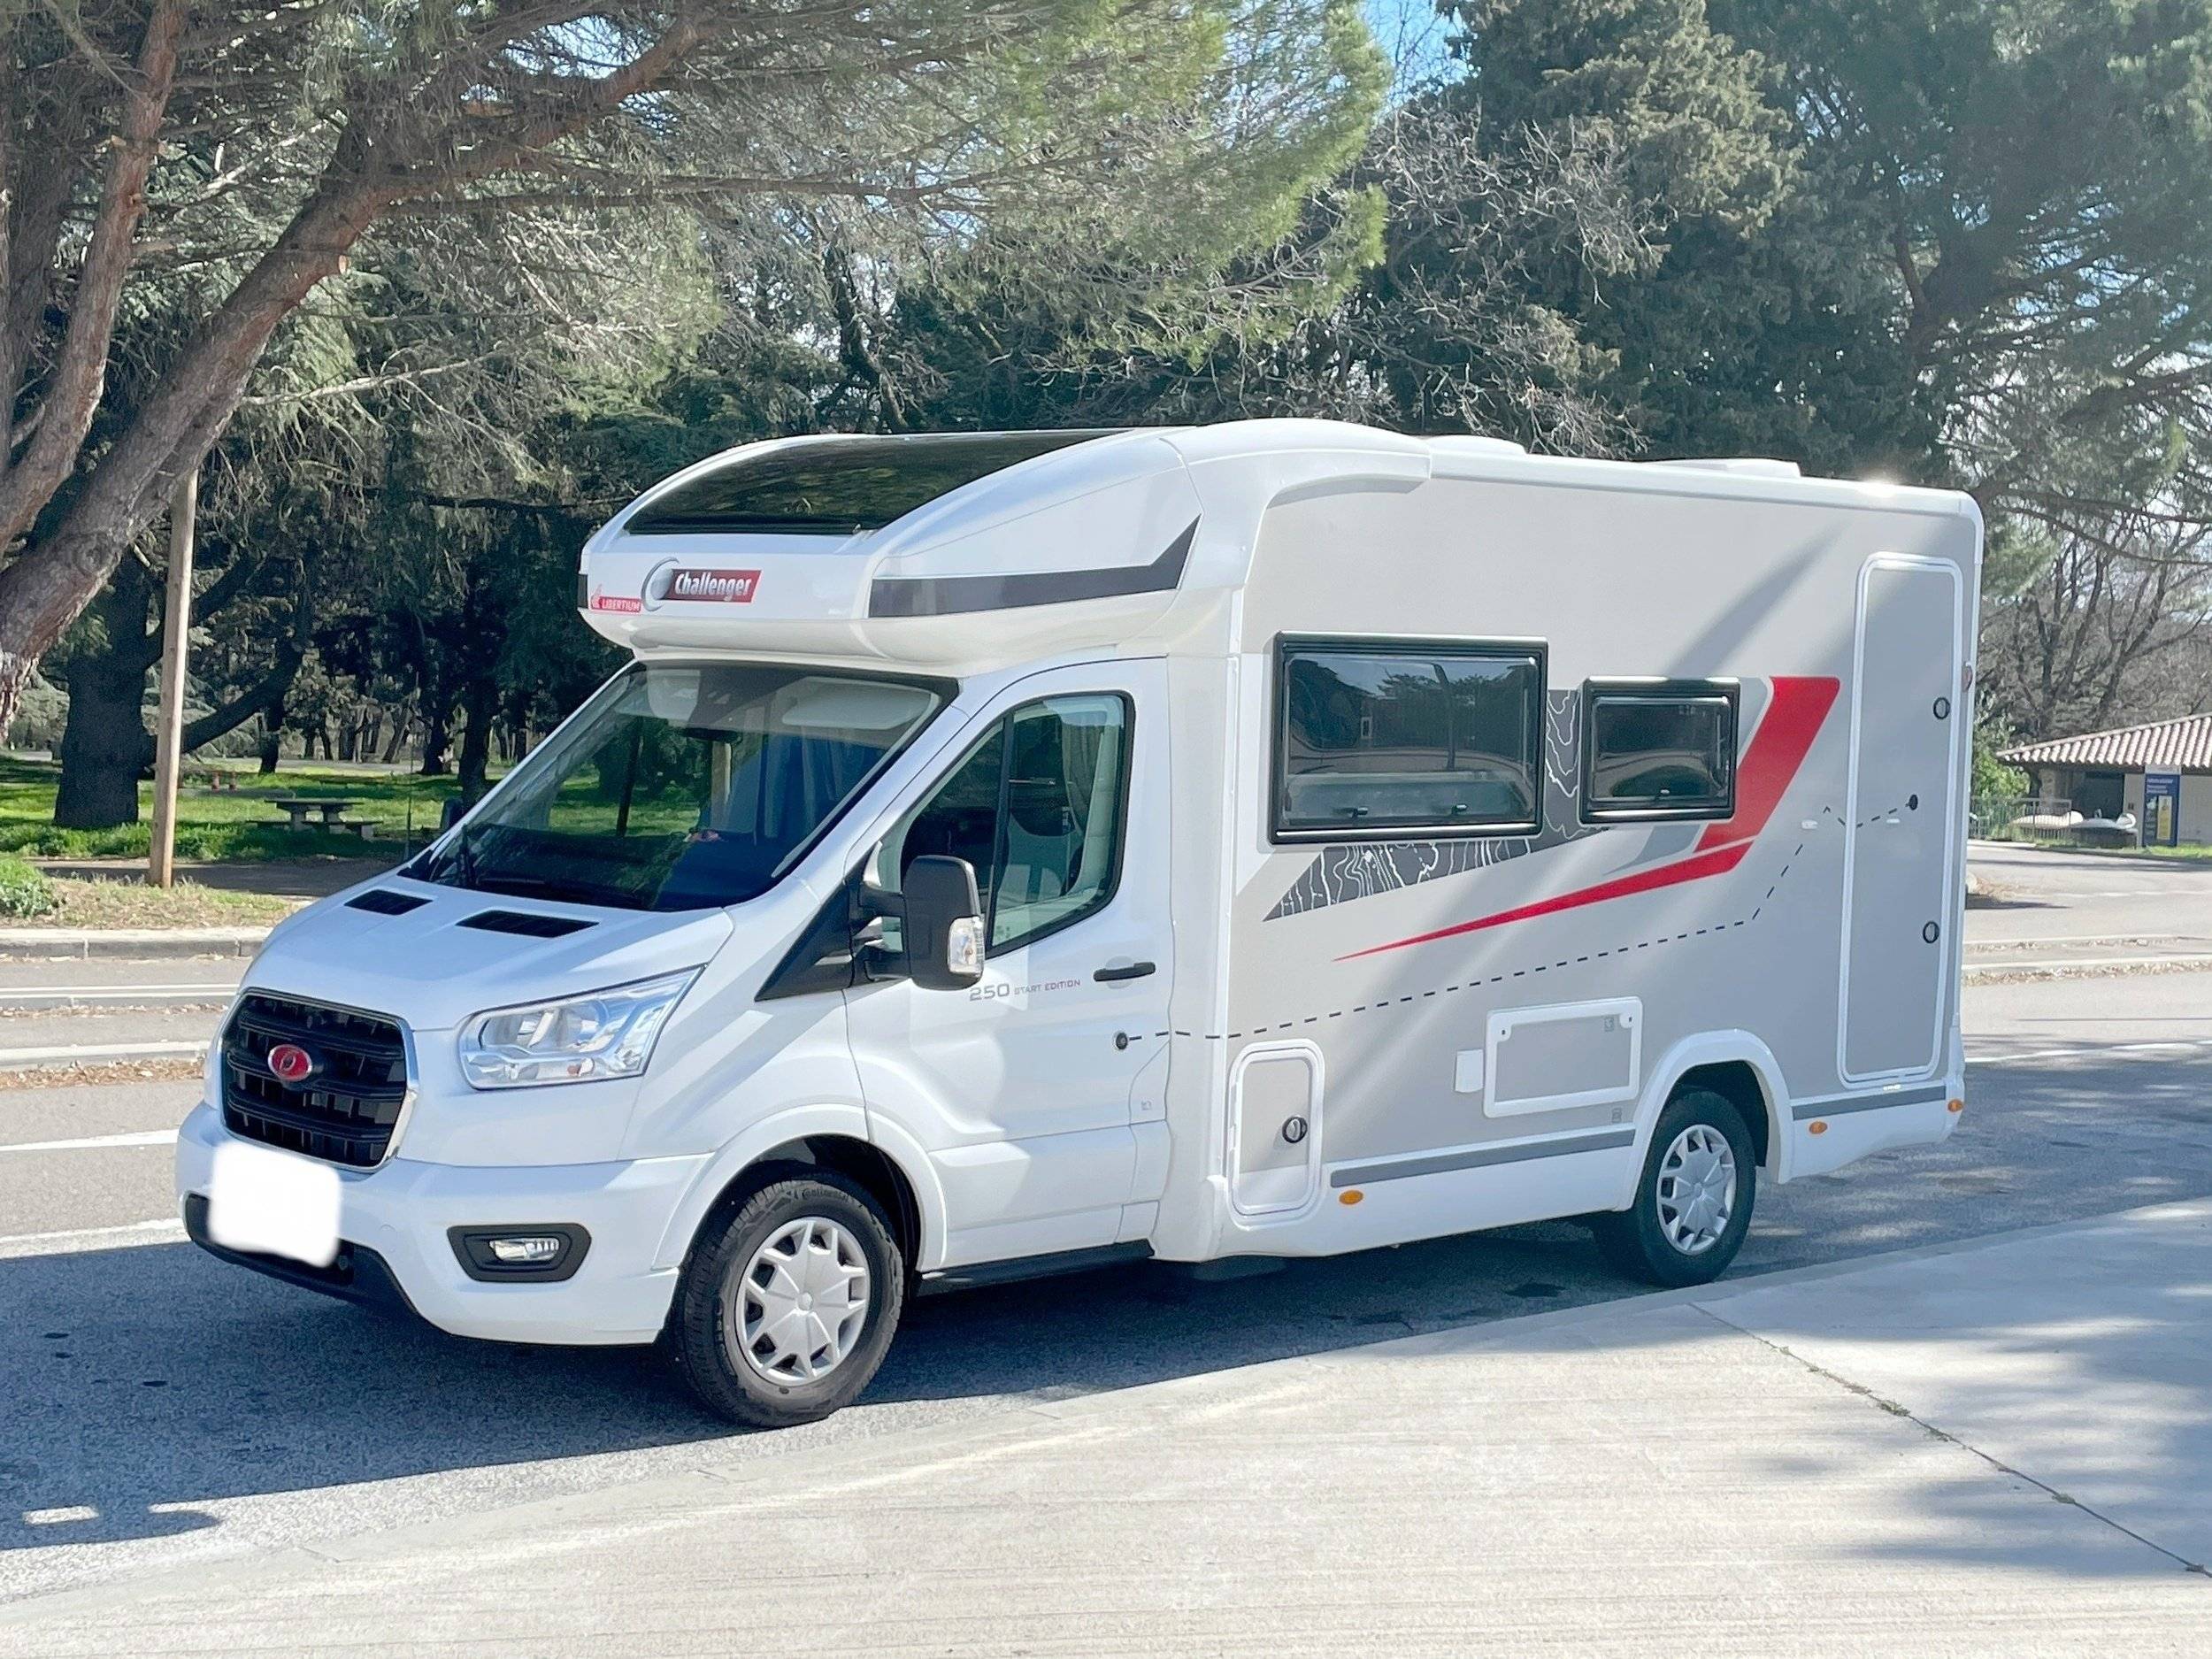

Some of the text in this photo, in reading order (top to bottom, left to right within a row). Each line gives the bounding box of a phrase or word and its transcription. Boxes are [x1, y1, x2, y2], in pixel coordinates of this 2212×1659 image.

[675, 572, 751, 602] Challenger
[602, 598, 641, 611] LIBERTIUM
[970, 979, 1081, 1002] 250 START EDITION
